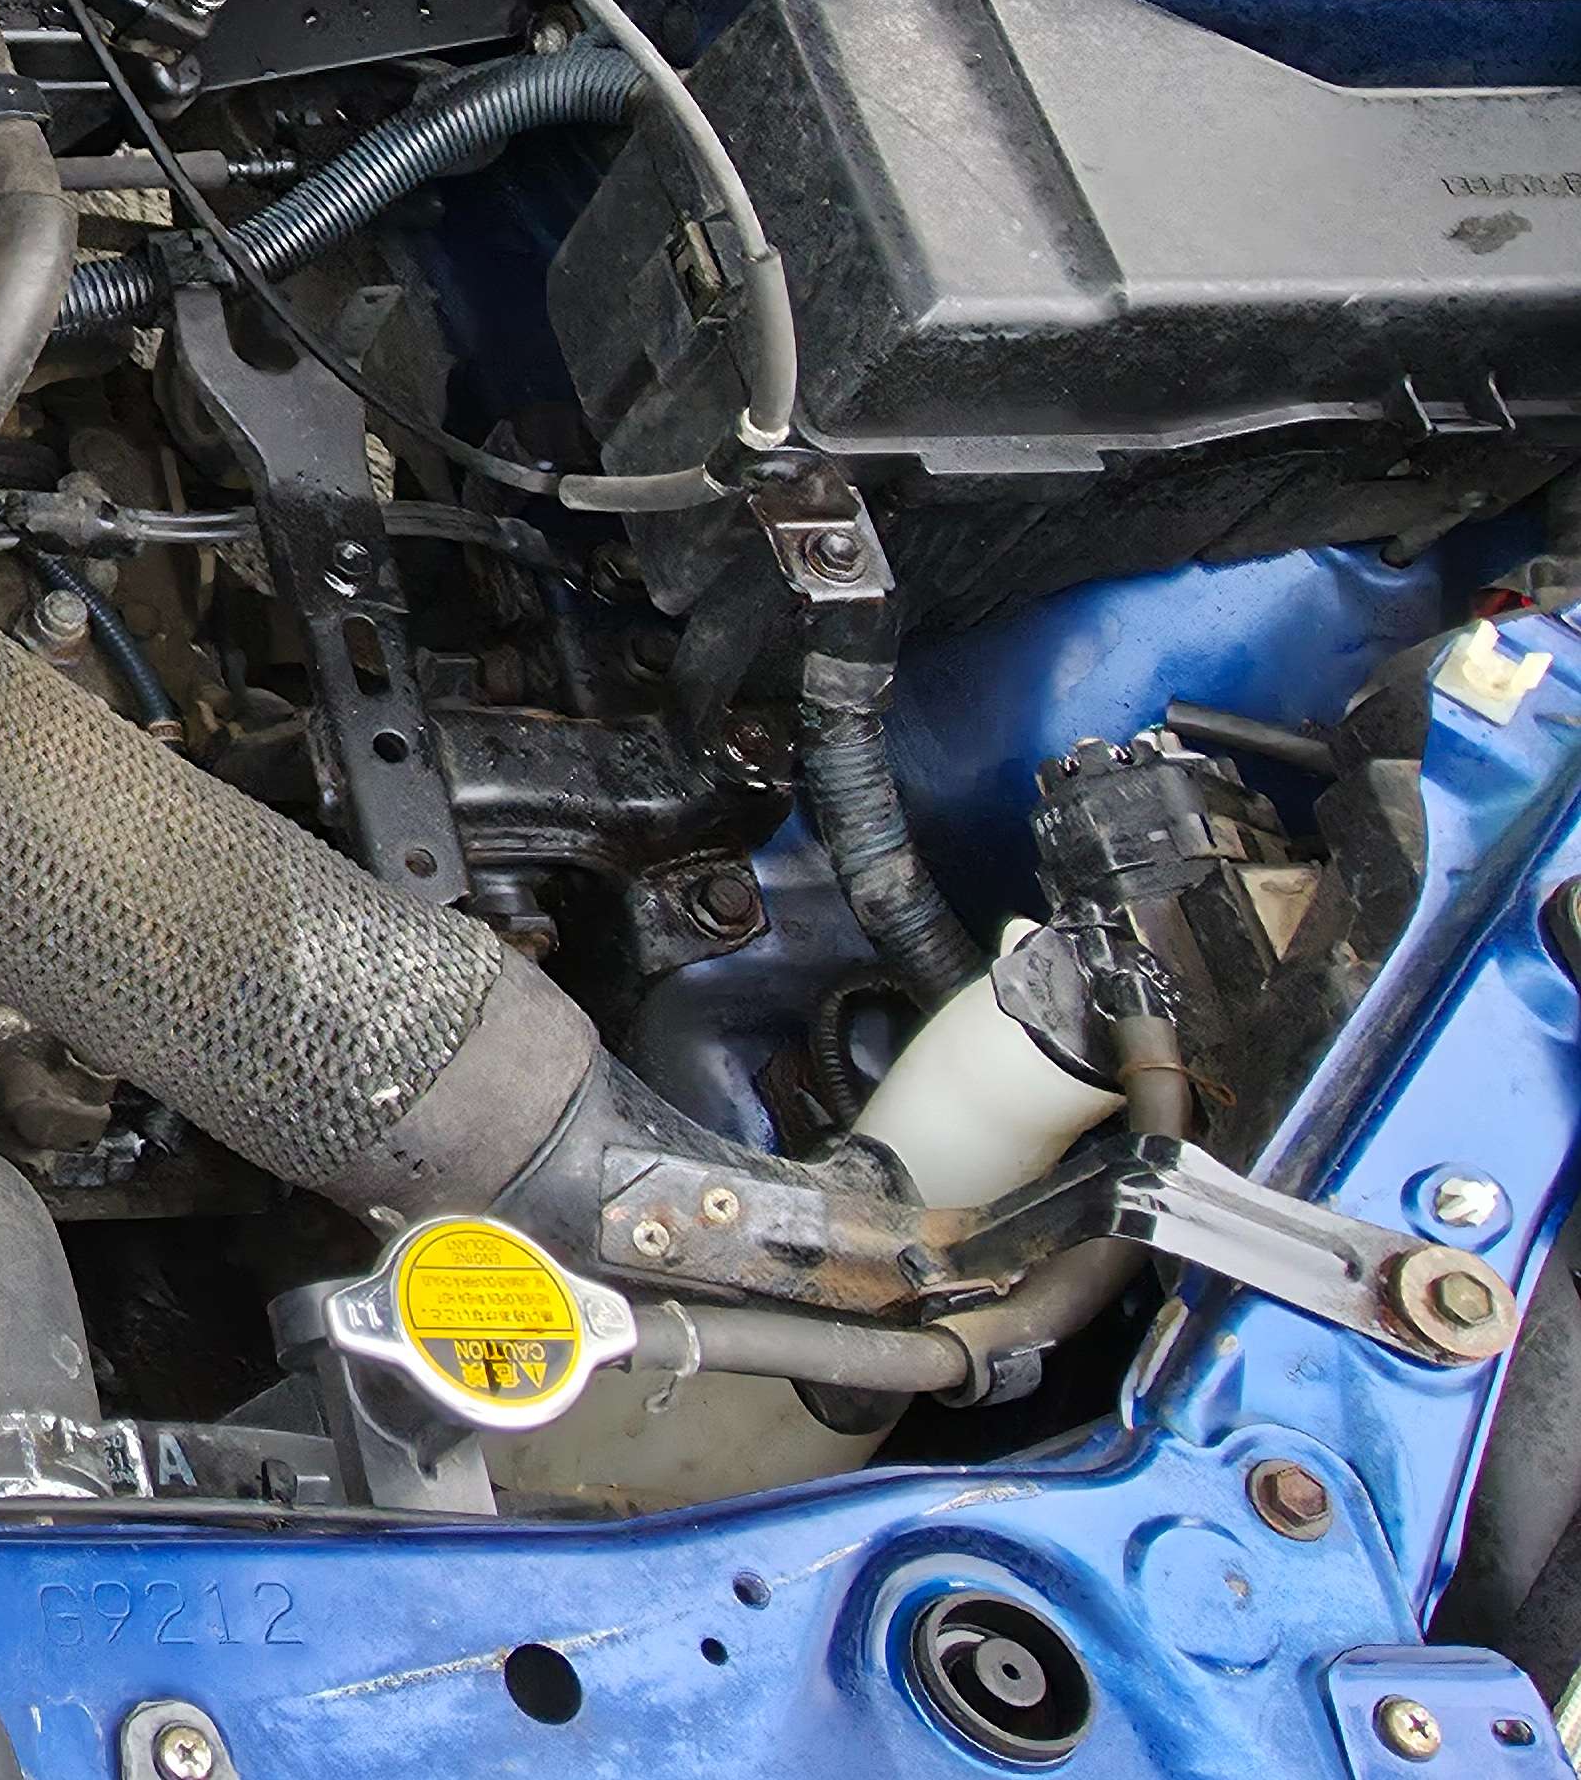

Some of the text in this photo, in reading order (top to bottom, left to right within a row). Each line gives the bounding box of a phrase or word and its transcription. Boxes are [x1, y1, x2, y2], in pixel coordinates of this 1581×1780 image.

[445, 1238, 502, 1251] COOLANT
[452, 1252, 502, 1265] ENGINE
[454, 1339, 546, 1362] CAUTION
